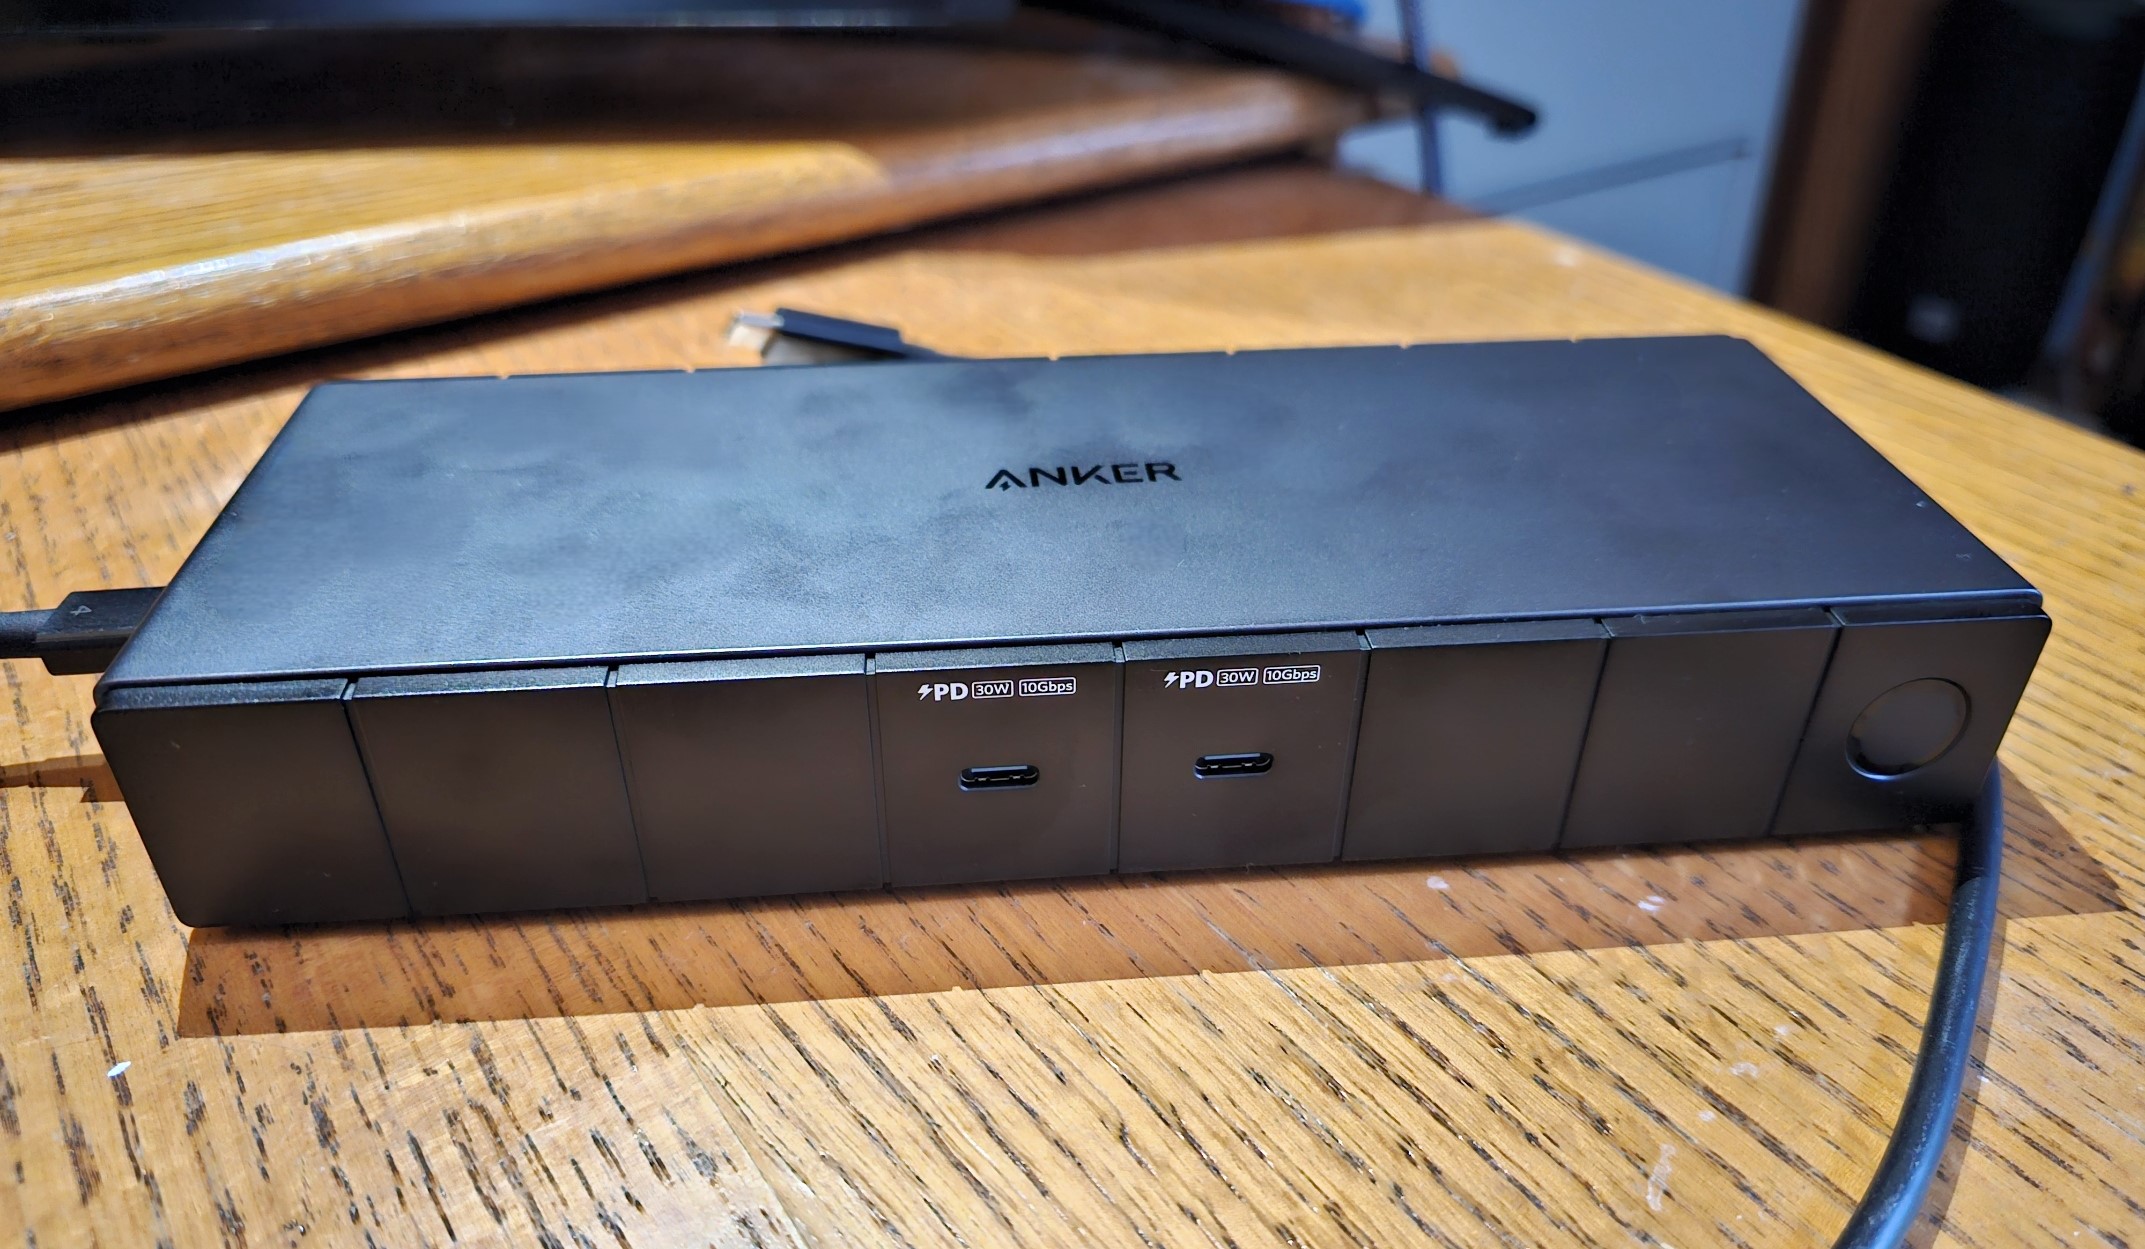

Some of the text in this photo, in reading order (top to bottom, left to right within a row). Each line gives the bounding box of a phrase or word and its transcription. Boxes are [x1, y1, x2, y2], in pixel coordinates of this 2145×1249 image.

[985, 463, 1182, 491] ANKER
[1179, 668, 1318, 688] PD 30W 10Gbps
[934, 680, 1074, 701] PD 30W 10Gbps
